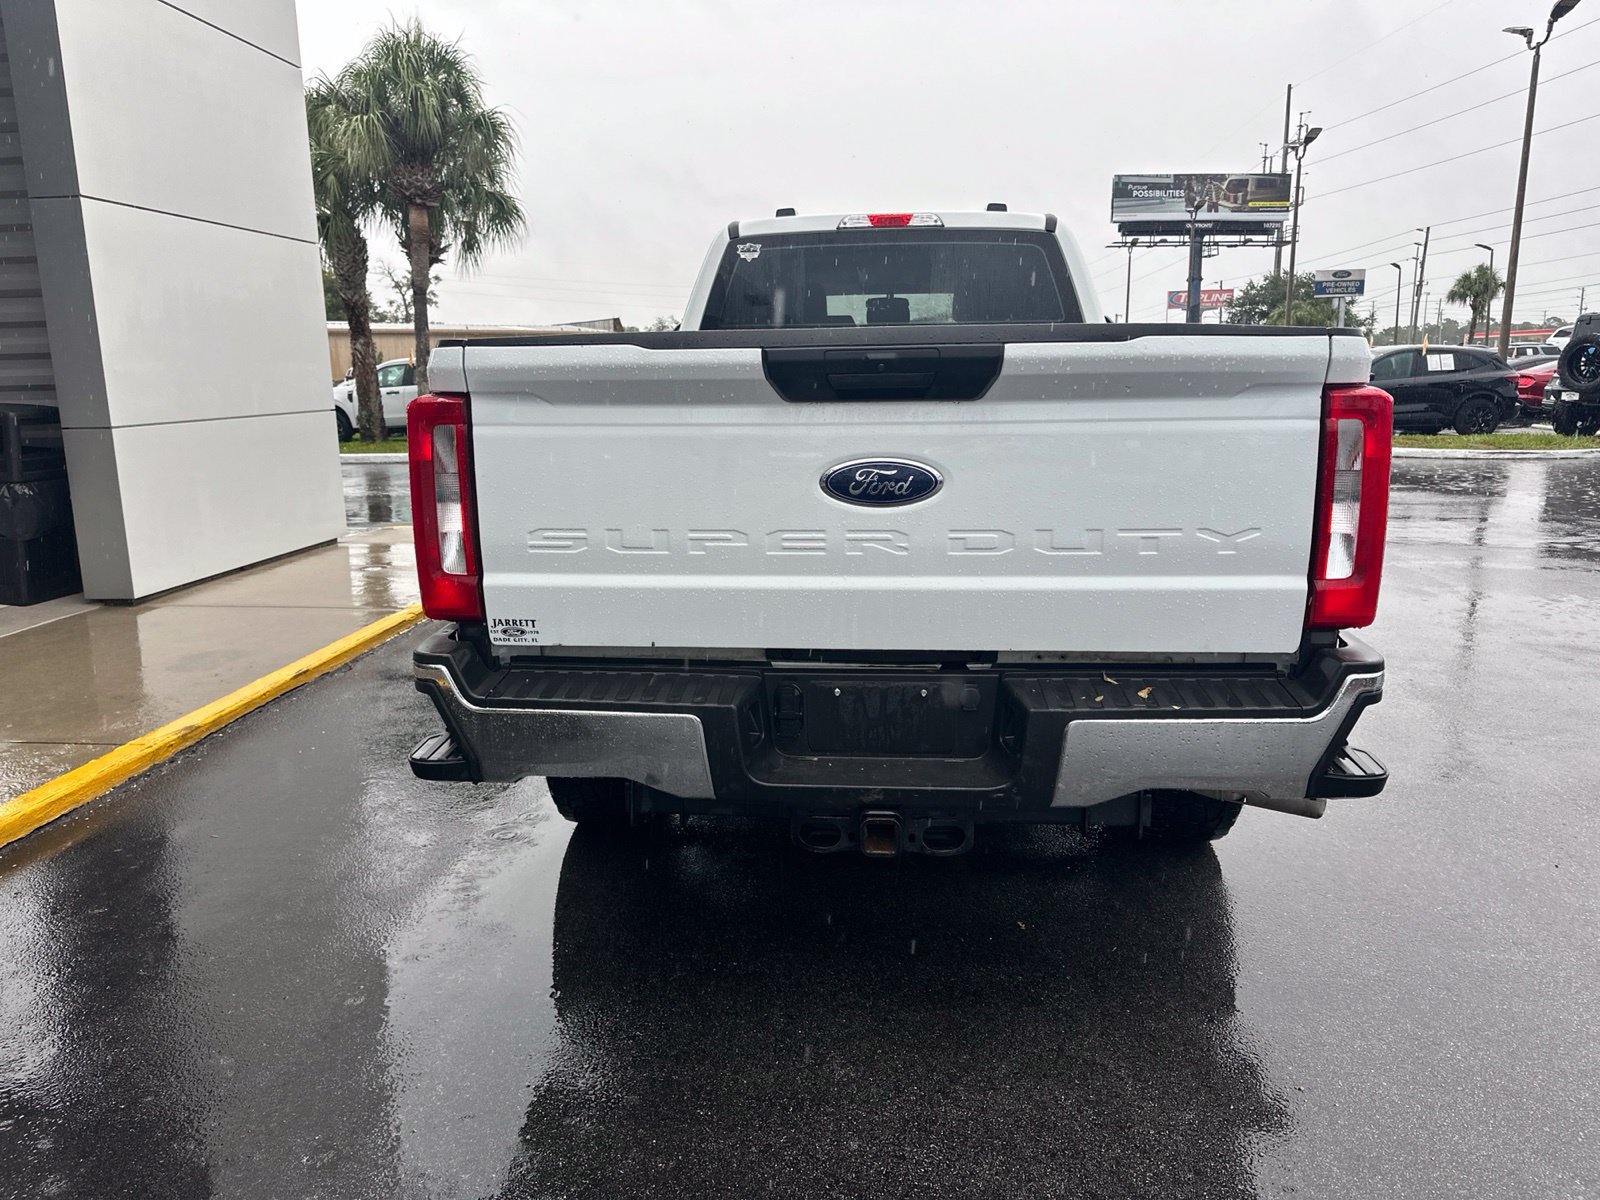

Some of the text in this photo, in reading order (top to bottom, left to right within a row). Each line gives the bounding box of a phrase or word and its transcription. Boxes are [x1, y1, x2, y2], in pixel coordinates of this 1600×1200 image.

[849, 468, 915, 496] Ford
[527, 527, 1261, 555] SUPER DUTY
[491, 618, 537, 629] JARRETT
